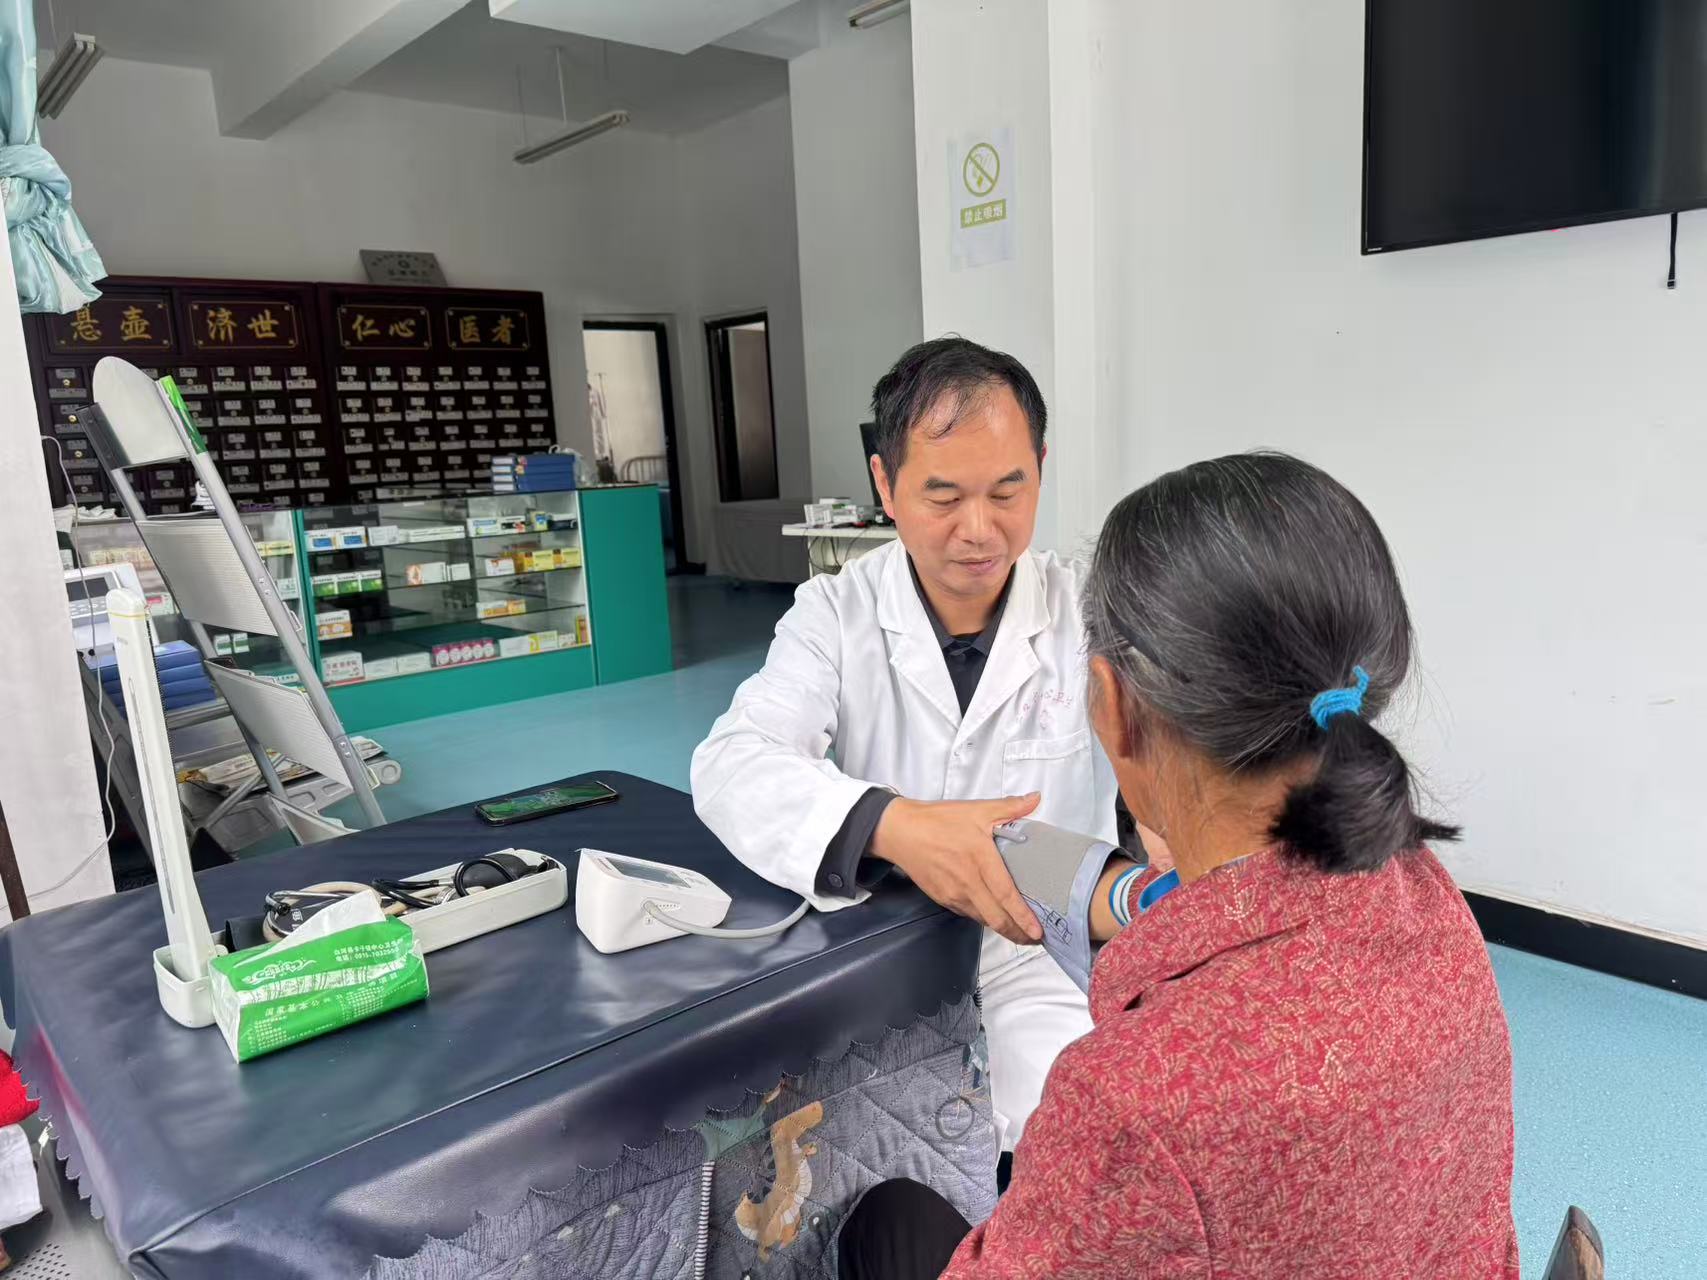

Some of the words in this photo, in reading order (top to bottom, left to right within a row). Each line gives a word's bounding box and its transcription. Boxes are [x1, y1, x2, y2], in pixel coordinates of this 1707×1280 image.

[70, 303, 152, 341] 悬壶
[207, 307, 279, 342] 济世
[352, 314, 416, 341] 仁心
[459, 315, 515, 345] 医者
